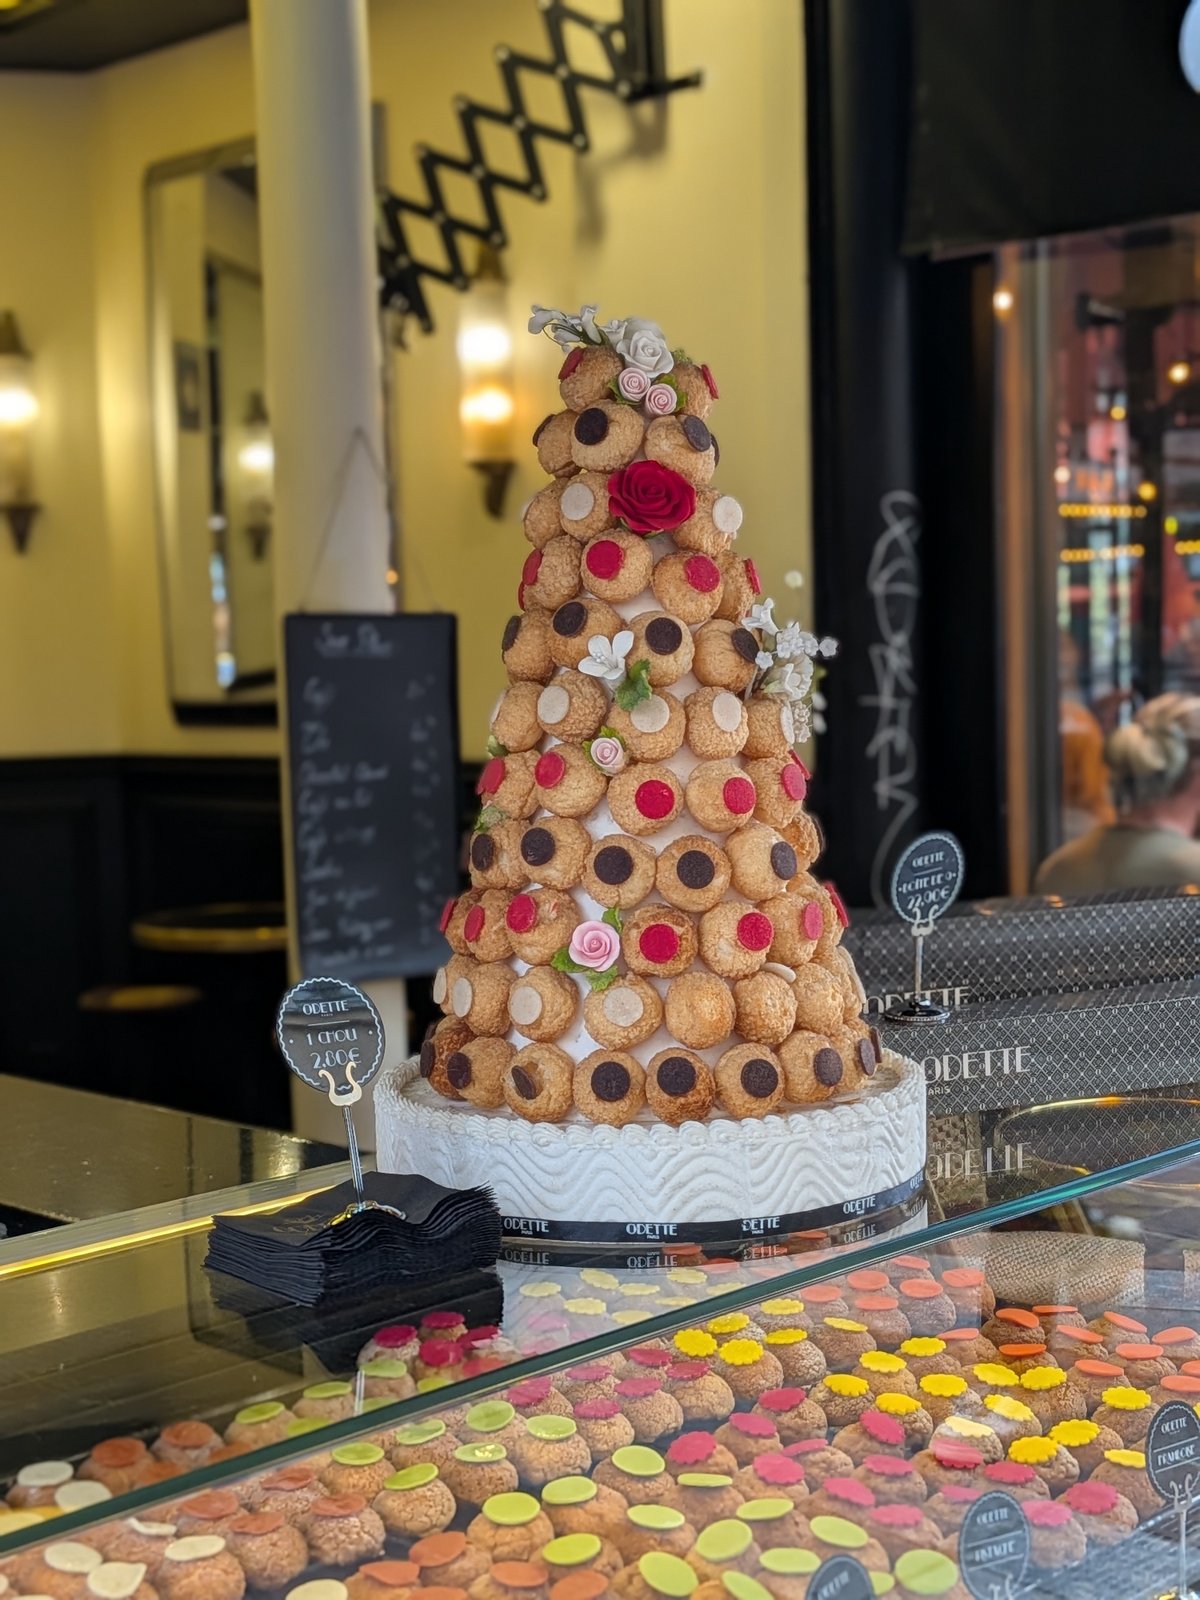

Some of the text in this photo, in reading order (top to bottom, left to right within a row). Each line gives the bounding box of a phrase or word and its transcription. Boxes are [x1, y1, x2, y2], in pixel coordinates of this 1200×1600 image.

[302, 1000, 349, 1015] ODETTE
[306, 1028, 358, 1045] 1 CHOU
[921, 1046, 1031, 1084] ODETTE
[928, 1086, 950, 1096] ARIS
[843, 1195, 876, 1214] ODETTE
[504, 1217, 549, 1233] ODETTE
[626, 1223, 677, 1236] ODETTE
[741, 1216, 780, 1231] DETTE
